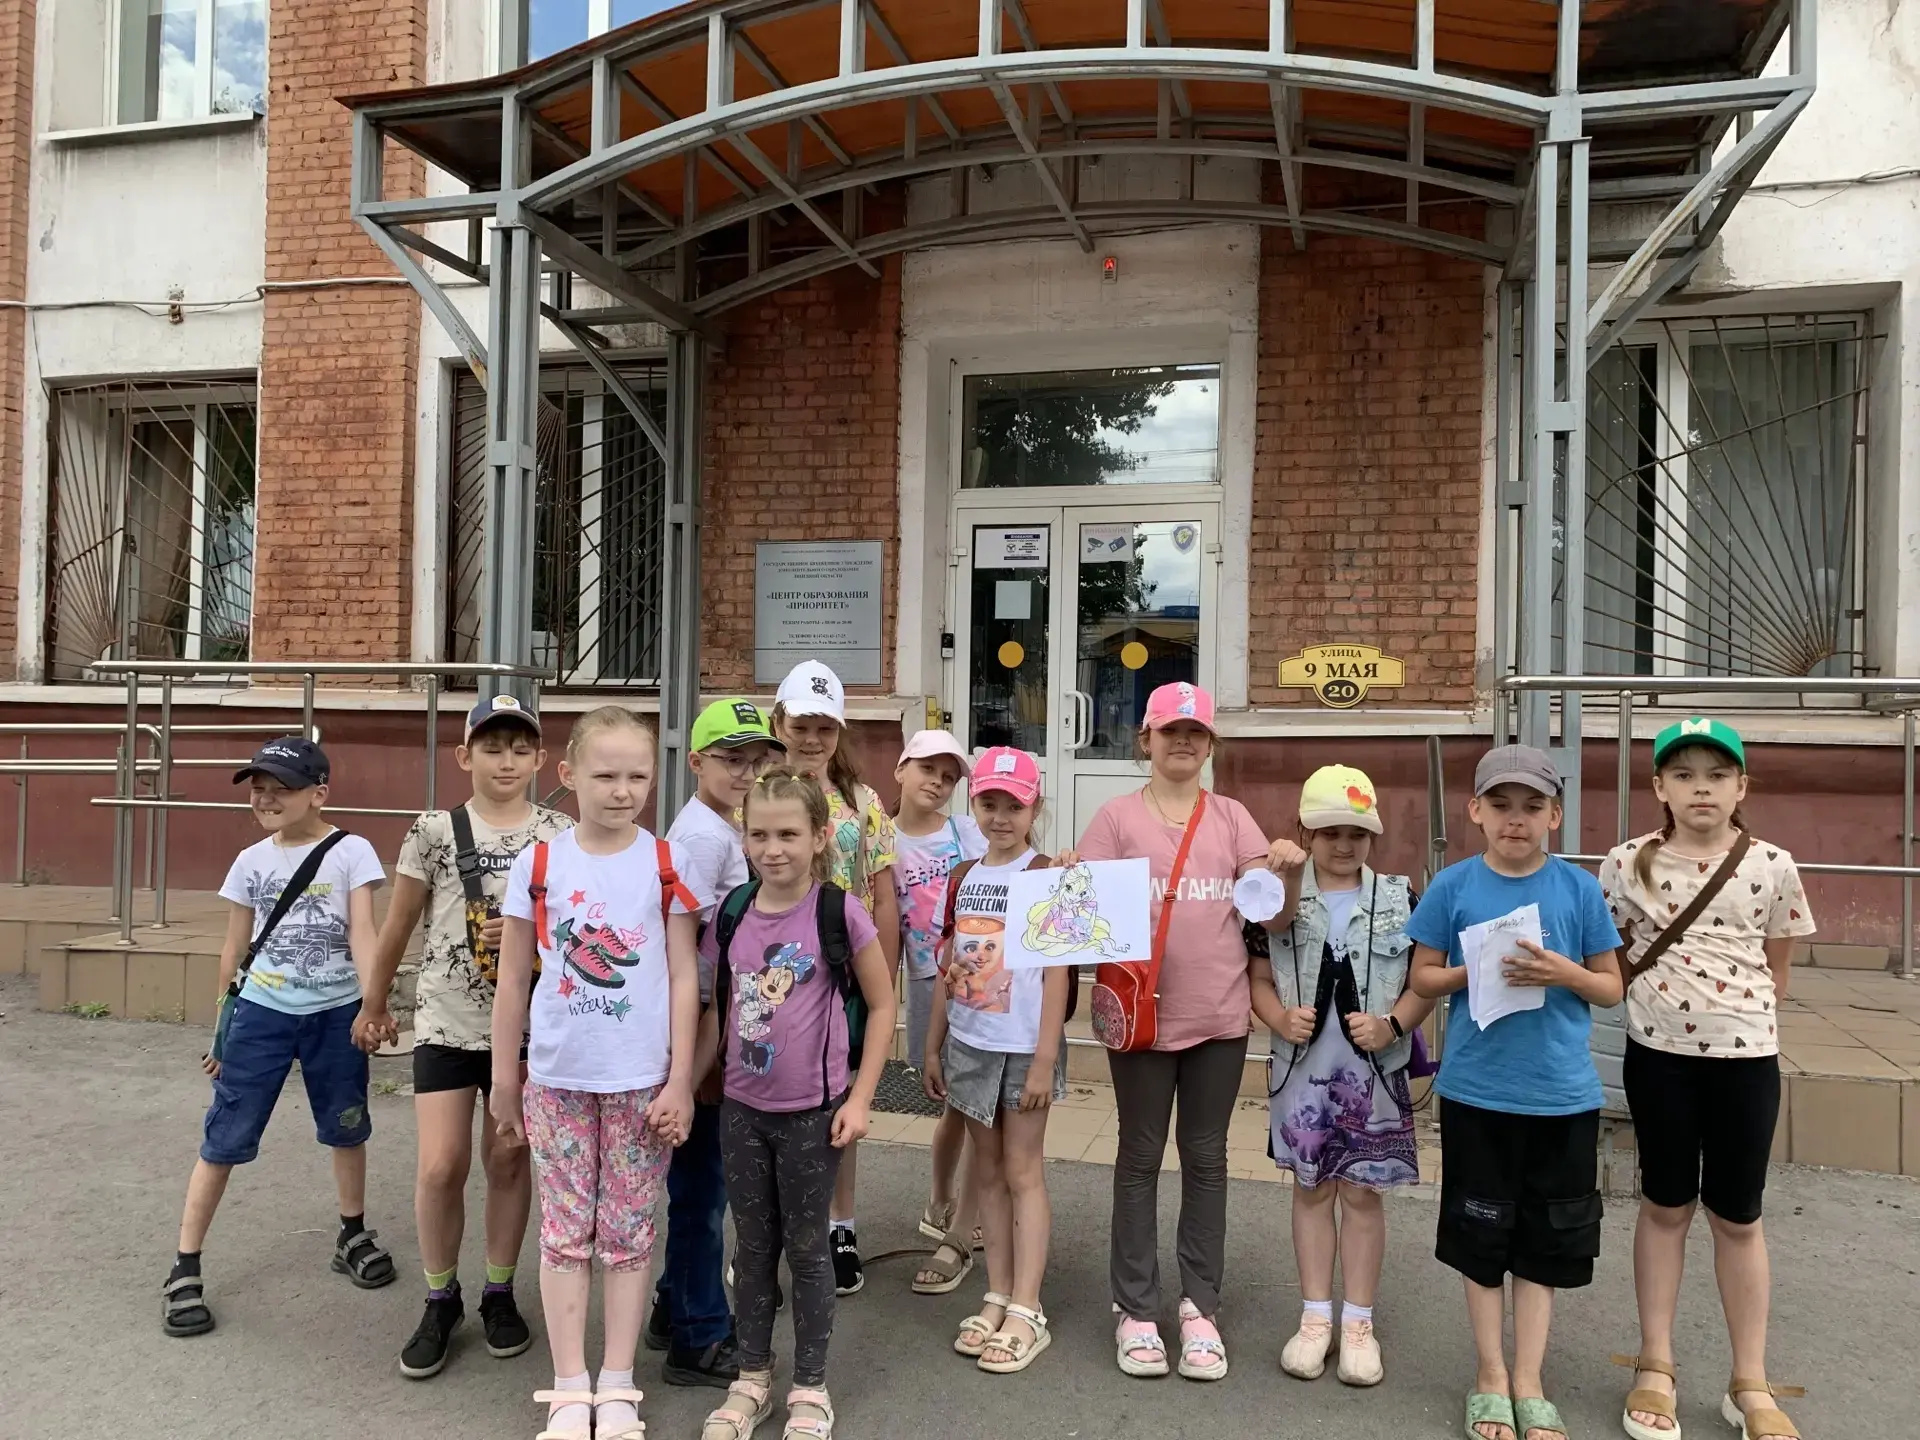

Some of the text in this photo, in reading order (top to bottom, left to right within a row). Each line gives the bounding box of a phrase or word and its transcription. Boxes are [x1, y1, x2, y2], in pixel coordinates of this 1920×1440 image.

[803, 591, 869, 600] ОБРАЗОВАНИЯ
[785, 601, 850, 610] «ПРИОРИТЕТ»
[1320, 649, 1362, 658] УЛИЦА
[1304, 663, 1378, 678] 9 МАЯ
[1327, 685, 1355, 698] 20
